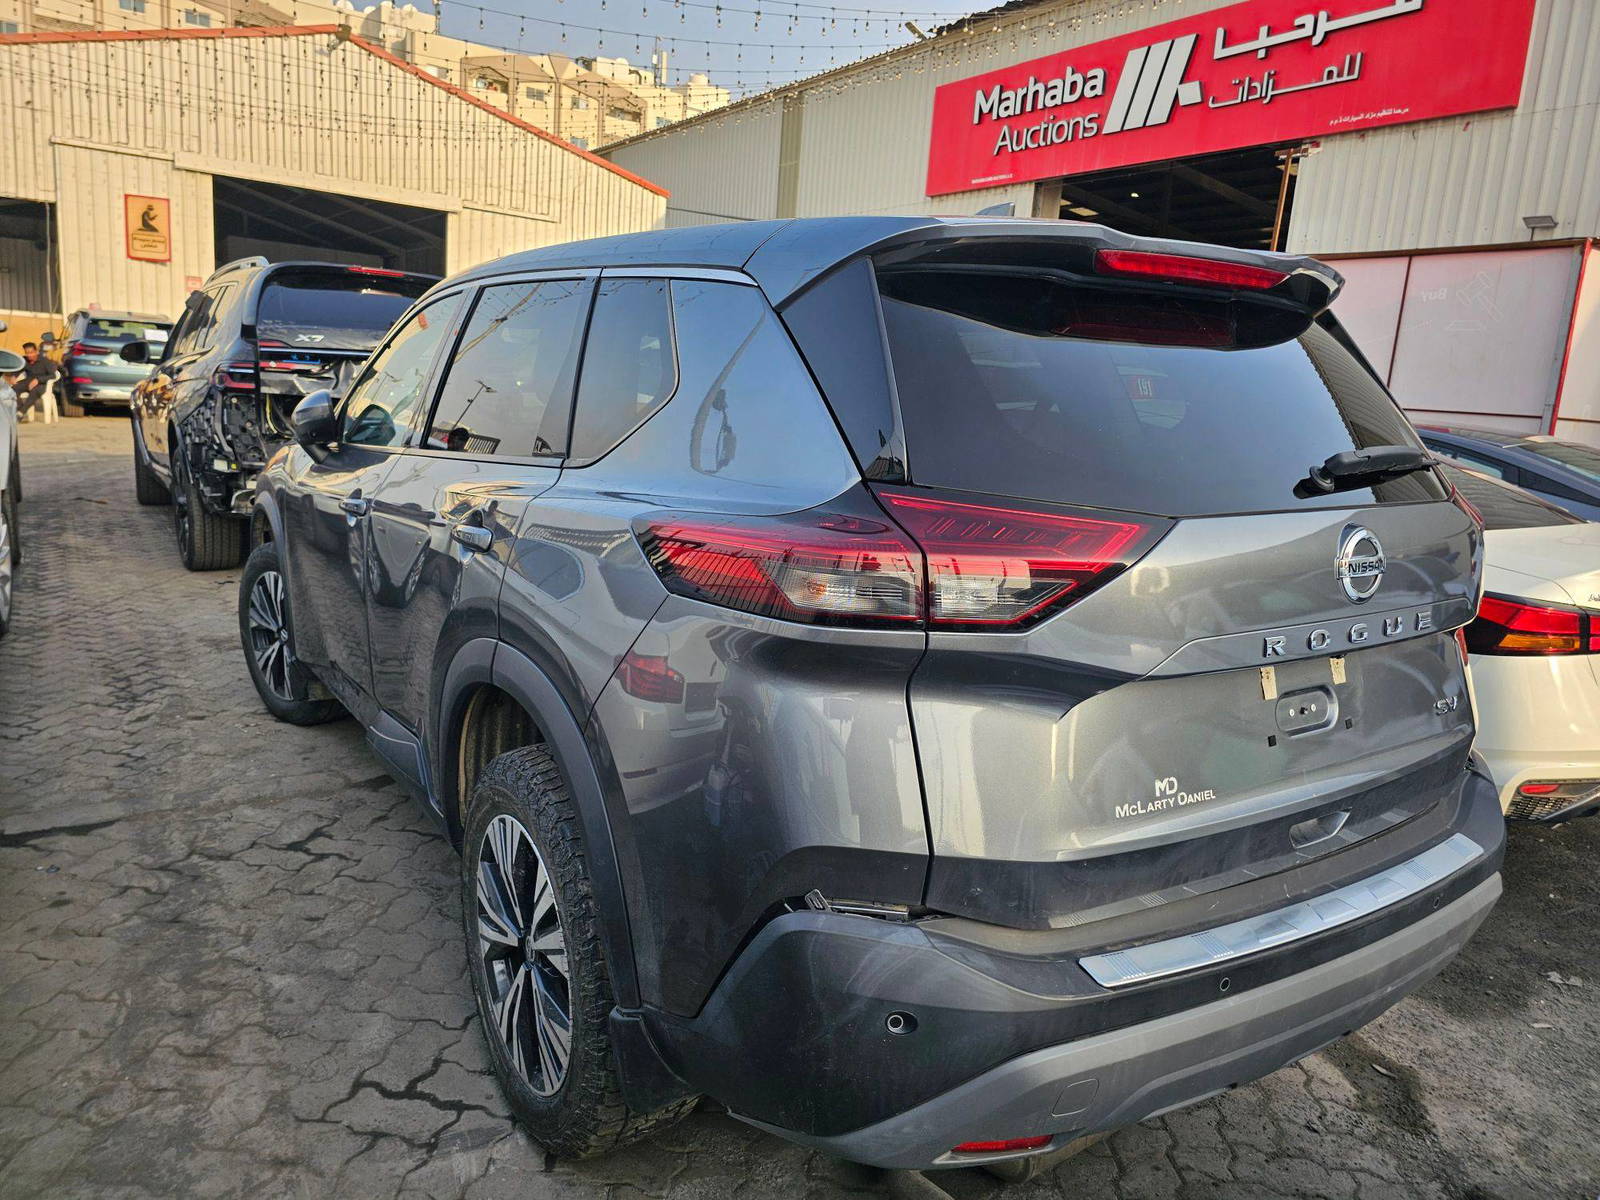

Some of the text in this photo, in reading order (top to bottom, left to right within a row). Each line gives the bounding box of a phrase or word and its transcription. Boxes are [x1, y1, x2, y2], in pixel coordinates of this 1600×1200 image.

[973, 66, 1106, 125] Marhaba
[1208, 51, 1363, 108] للمزادات
[993, 112, 1100, 156] Auctions
[1348, 559, 1384, 574] NISSA
[1264, 611, 1432, 658] ROGUE
[1433, 696, 1458, 716] SV
[1154, 776, 1179, 797] MD
